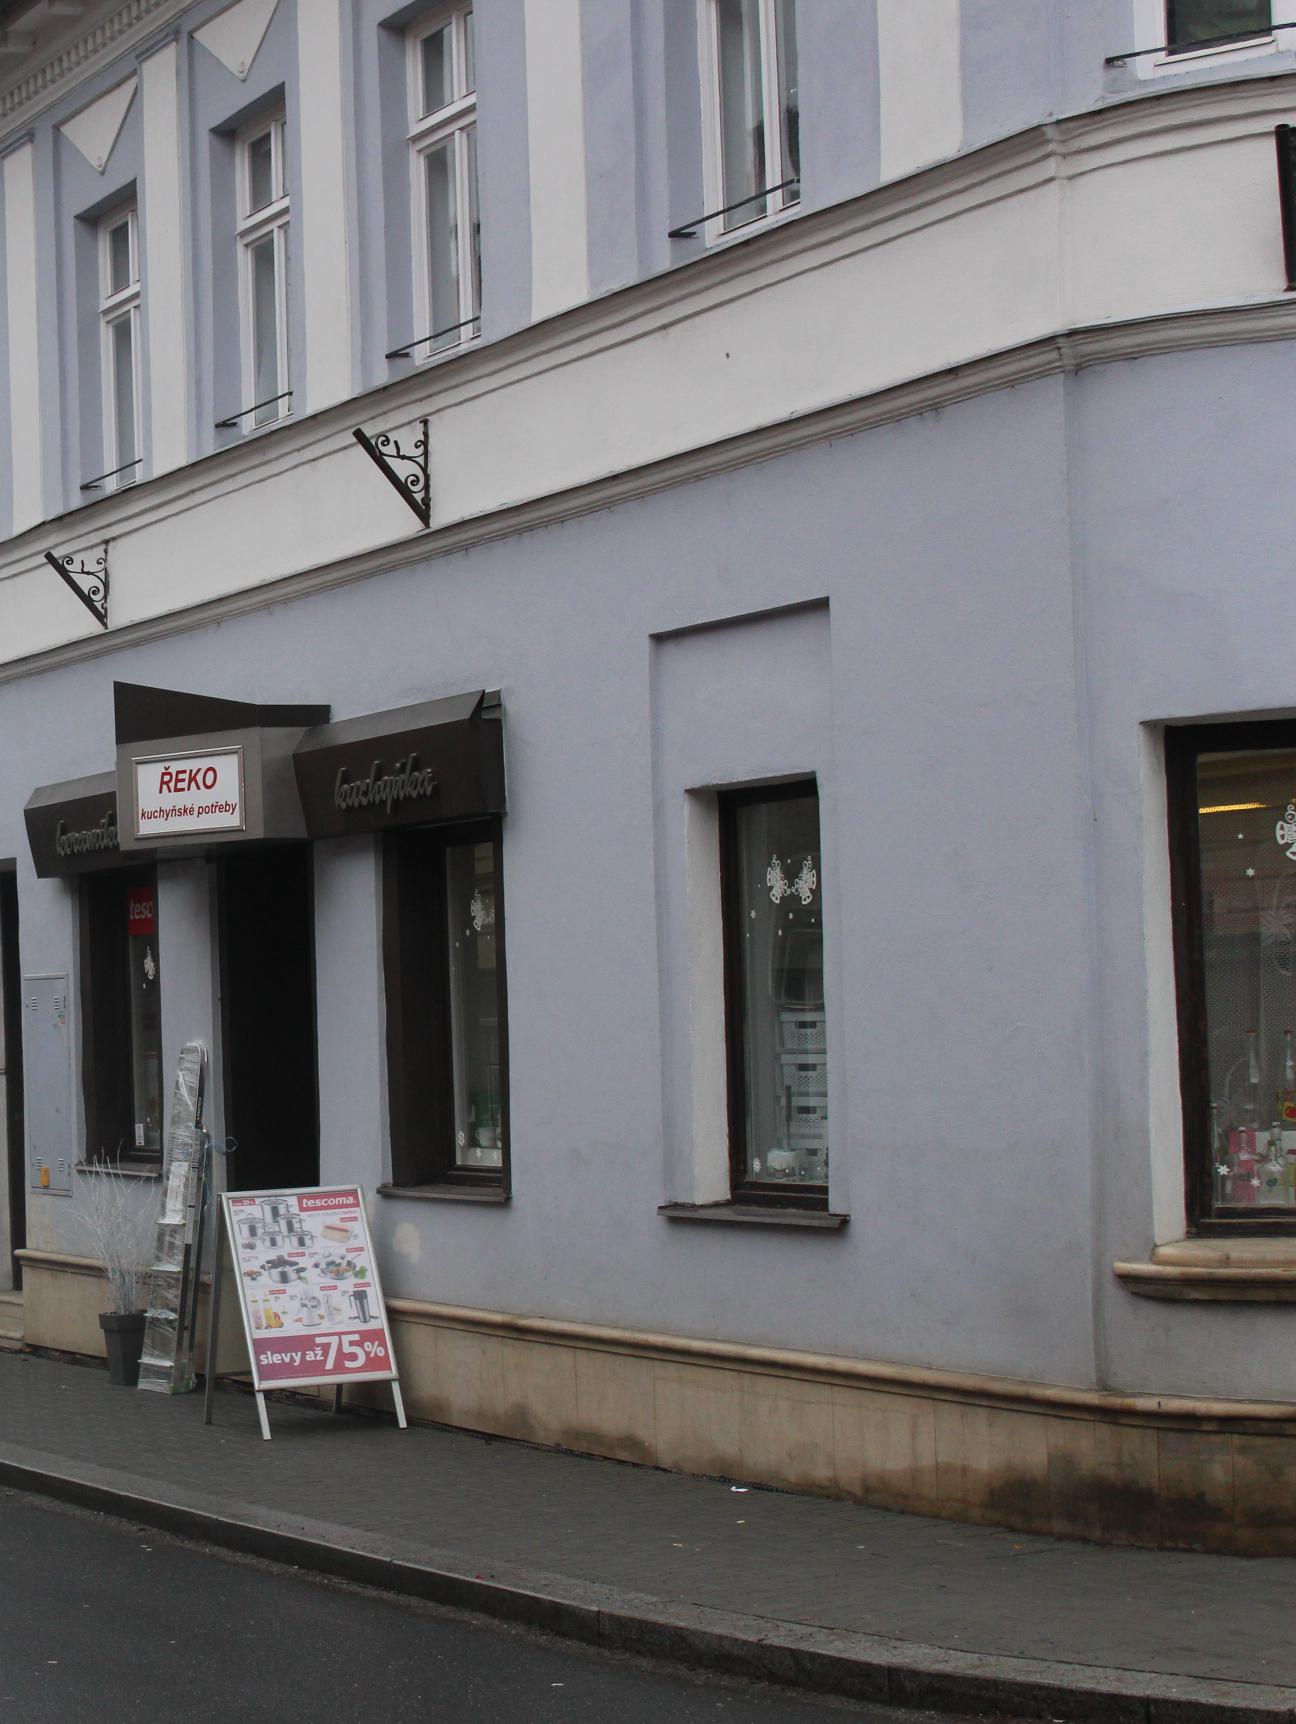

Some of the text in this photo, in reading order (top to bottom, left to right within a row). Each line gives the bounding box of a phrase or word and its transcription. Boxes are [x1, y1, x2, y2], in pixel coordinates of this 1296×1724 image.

[159, 765, 218, 795] ŘEKO
[140, 801, 237, 821] kuchyňské potřeby
[259, 1334, 385, 1370] slevy až 75%
